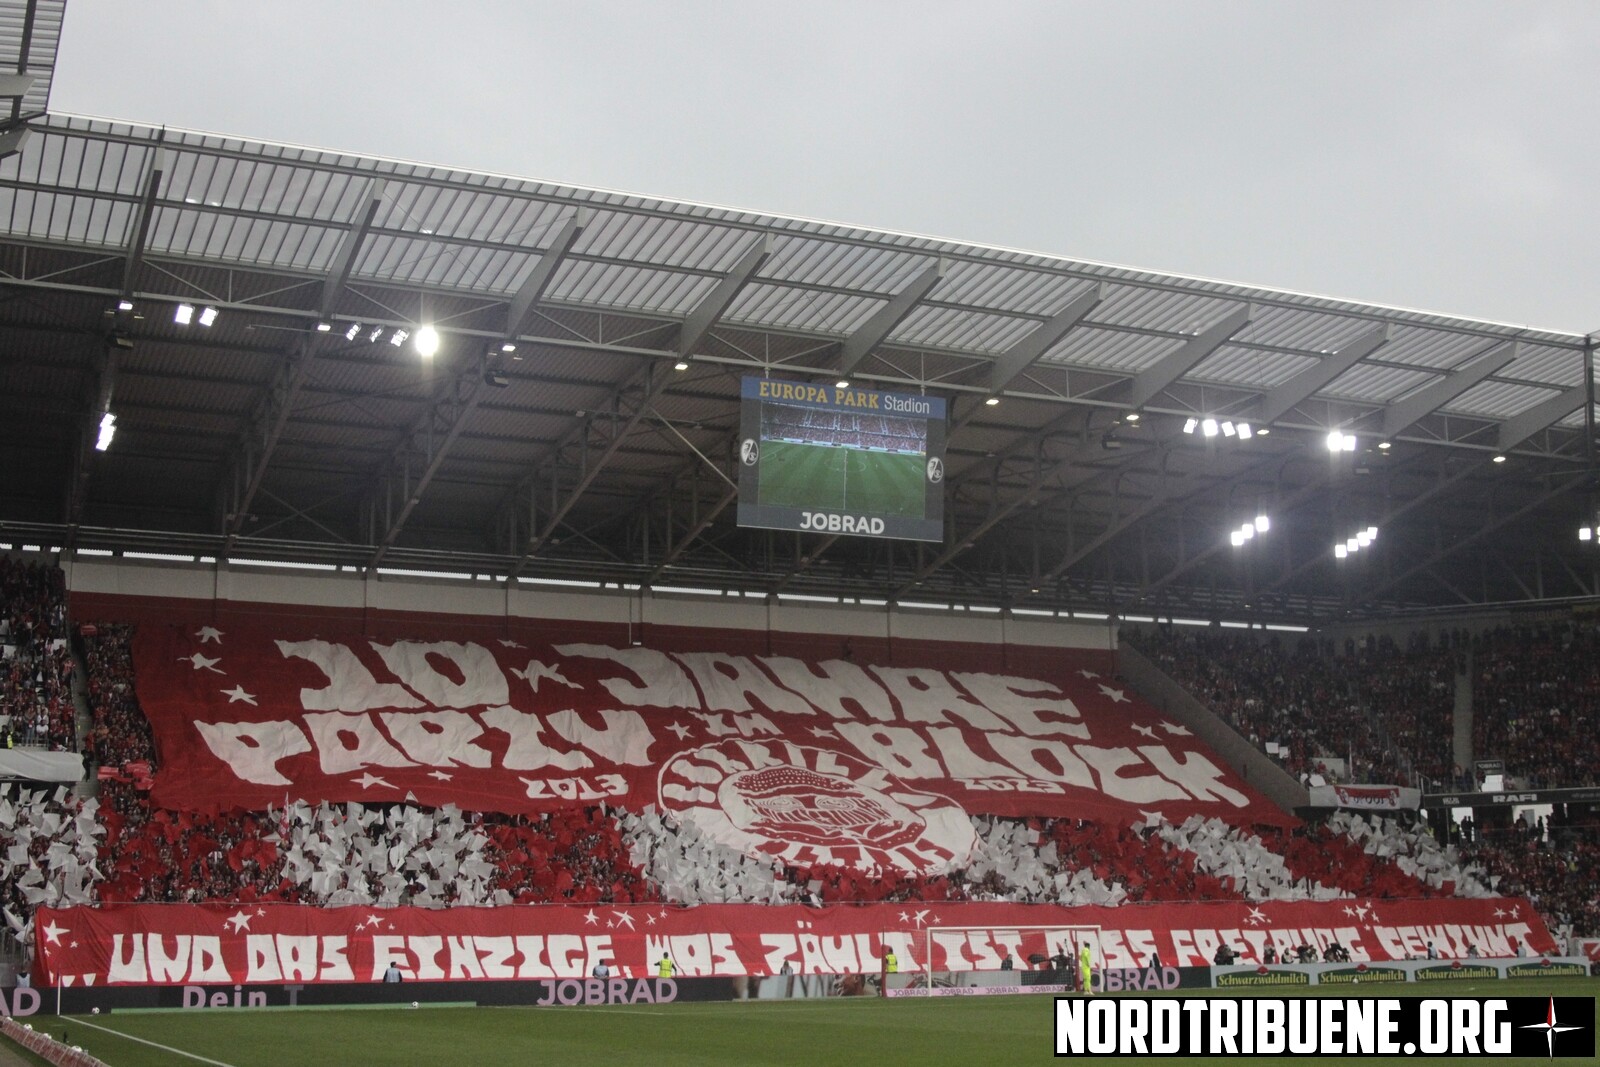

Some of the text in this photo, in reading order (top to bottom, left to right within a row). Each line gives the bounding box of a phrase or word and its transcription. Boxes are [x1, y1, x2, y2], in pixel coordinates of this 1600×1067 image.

[759, 381, 930, 415] EUROPA PARK Stadion
[800, 511, 885, 535] JOBRAD
[551, 642, 1092, 740] JAHRE
[833, 722, 1250, 808] BLOCK
[518, 773, 629, 800] 2013
[953, 778, 1066, 795] 2023
[1492, 793, 1538, 803] RAFI
[246, 933, 354, 982] DAS
[1080, 967, 1181, 991] OBRAD
[1218, 972, 1307, 986] Schwarzwaldmilch
[1320, 969, 1404, 984] Schwarzwaldmilch
[1416, 967, 1497, 980] Schwarzwaldmilch
[182, 984, 267, 1009] Dein
[536, 977, 678, 1006] JOBRAD
